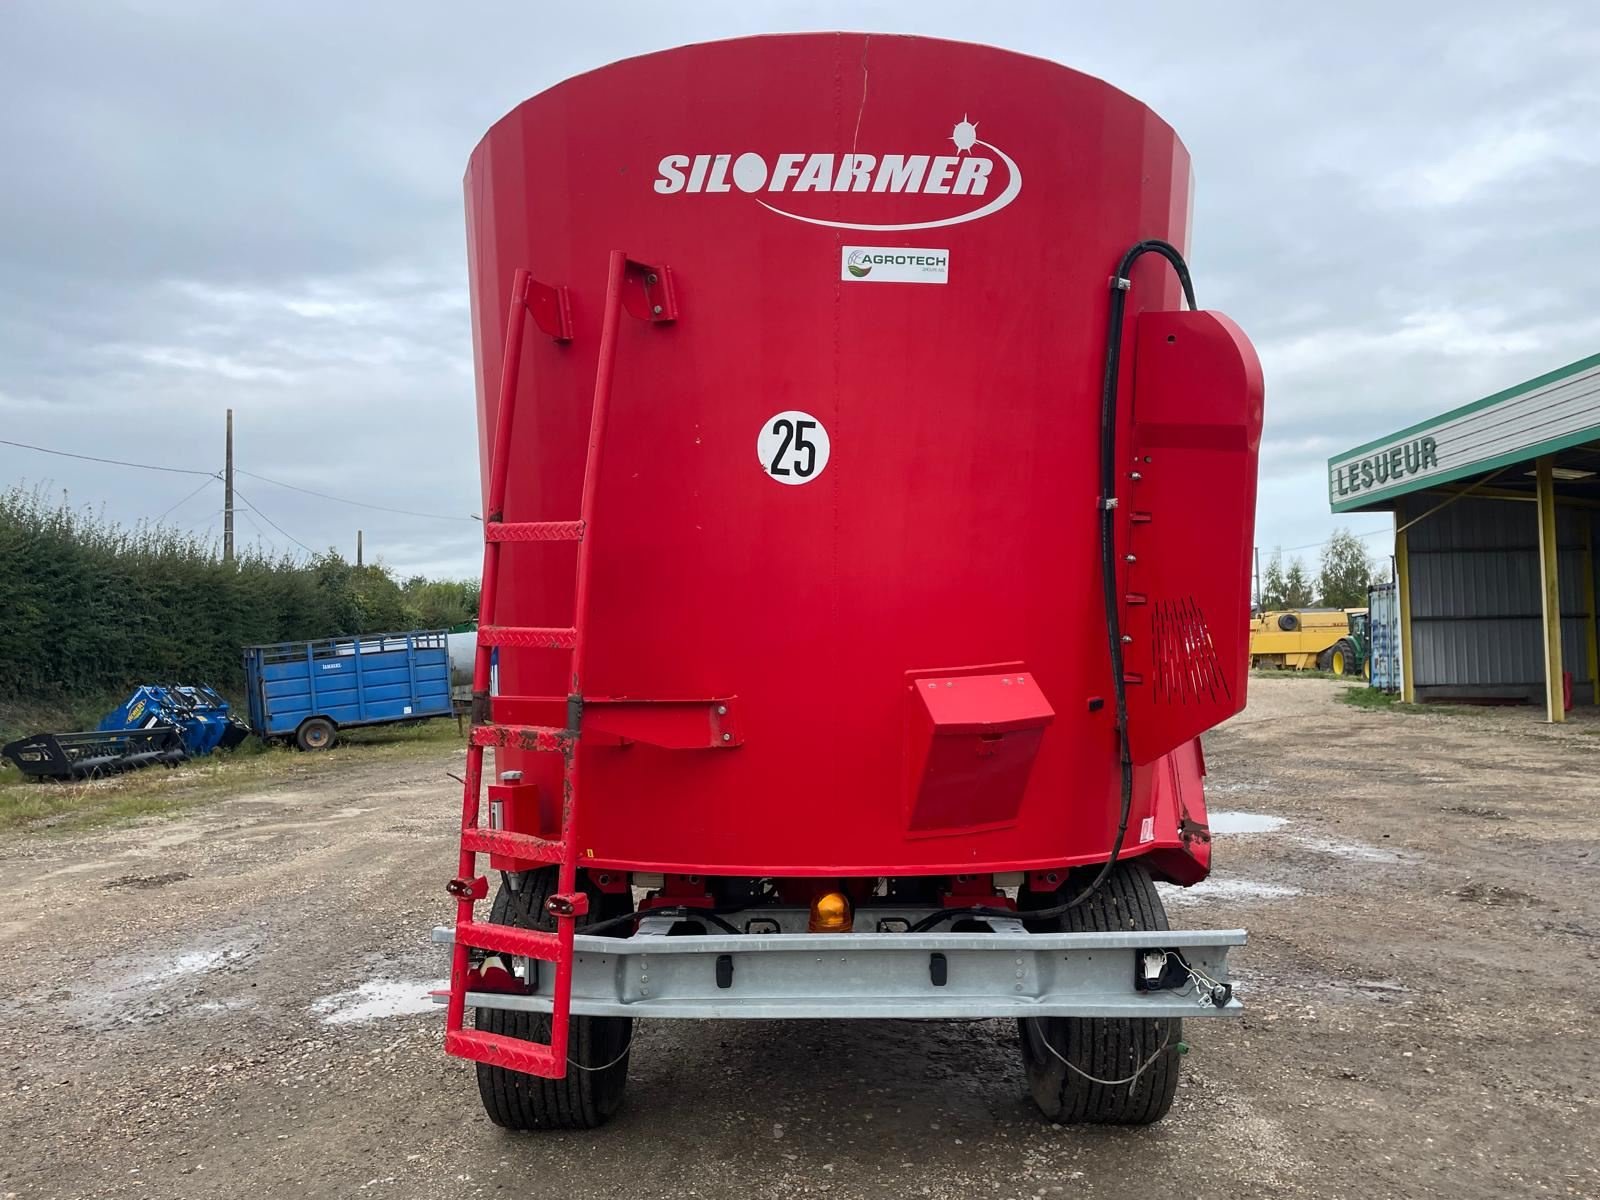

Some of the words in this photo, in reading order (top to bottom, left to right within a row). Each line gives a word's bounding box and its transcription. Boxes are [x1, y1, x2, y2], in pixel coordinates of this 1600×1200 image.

[653, 152, 994, 196] SILOFARMER
[861, 253, 946, 267] AGROTECH
[770, 418, 817, 478] 25
[1337, 436, 1438, 496] LESUEUR
